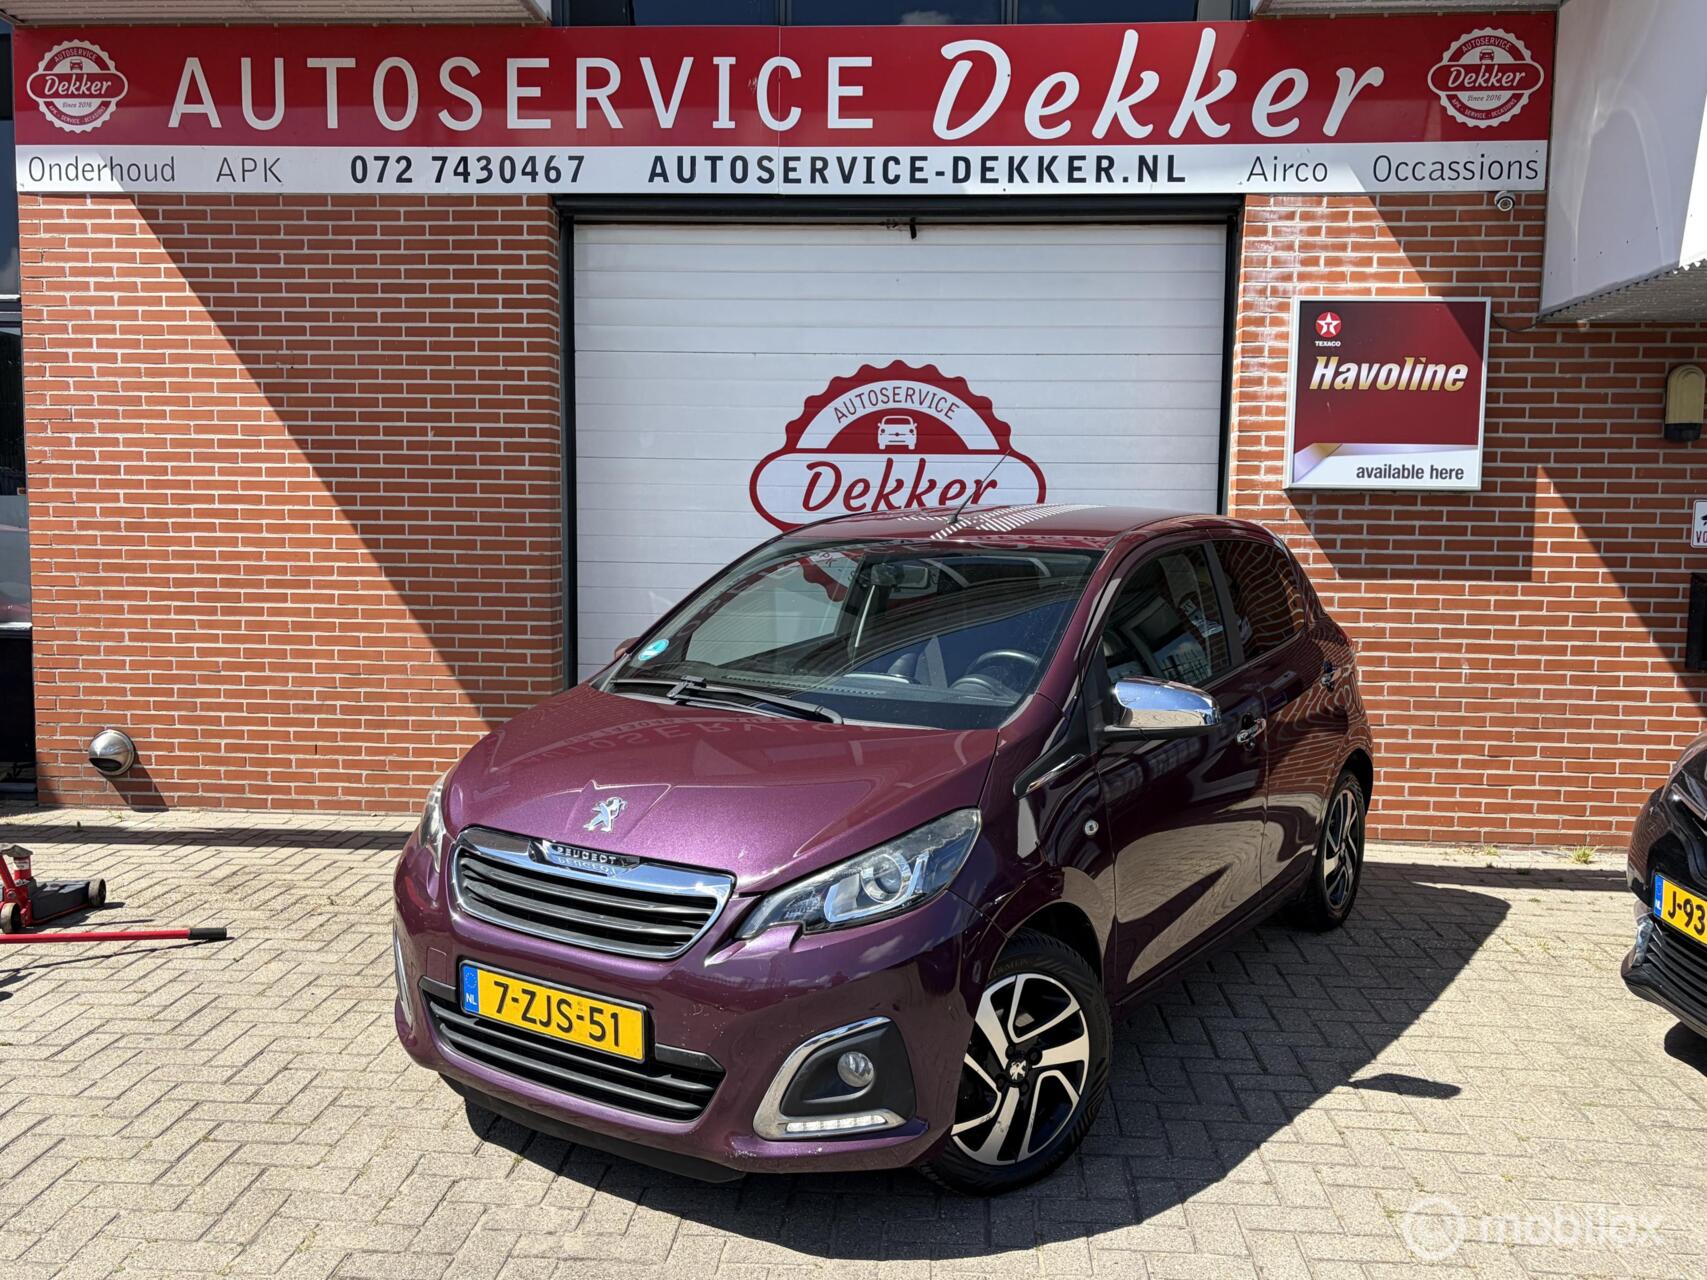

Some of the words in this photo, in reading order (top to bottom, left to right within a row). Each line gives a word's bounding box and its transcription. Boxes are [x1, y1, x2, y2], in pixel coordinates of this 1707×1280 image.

[54, 48, 98, 62] AUTOSERVICE
[1461, 36, 1512, 53] AUTOSERVICE
[44, 73, 112, 96] Dekker
[168, 56, 874, 131] AUTOSERVICE
[932, 27, 1385, 141] Dekker
[1448, 64, 1526, 88] Dekker
[28, 156, 175, 183] Onderhoud
[216, 157, 283, 183] APK
[351, 155, 413, 184] 072
[431, 155, 585, 184] 7430467
[648, 154, 1185, 184] AUTOSERVICE-DEKKER.NL
[1246, 155, 1328, 183] Airco
[1373, 154, 1539, 183] Occassions
[1309, 356, 1469, 392] Havoline
[833, 386, 960, 424] AUTOSERVICE
[1356, 463, 1425, 480] available
[1429, 464, 1464, 480] here
[802, 457, 998, 512] Dekker
[557, 846, 617, 865] PEUGEOT
[466, 993, 477, 1006] NL
[493, 980, 620, 1047] 7-ZJS-51
